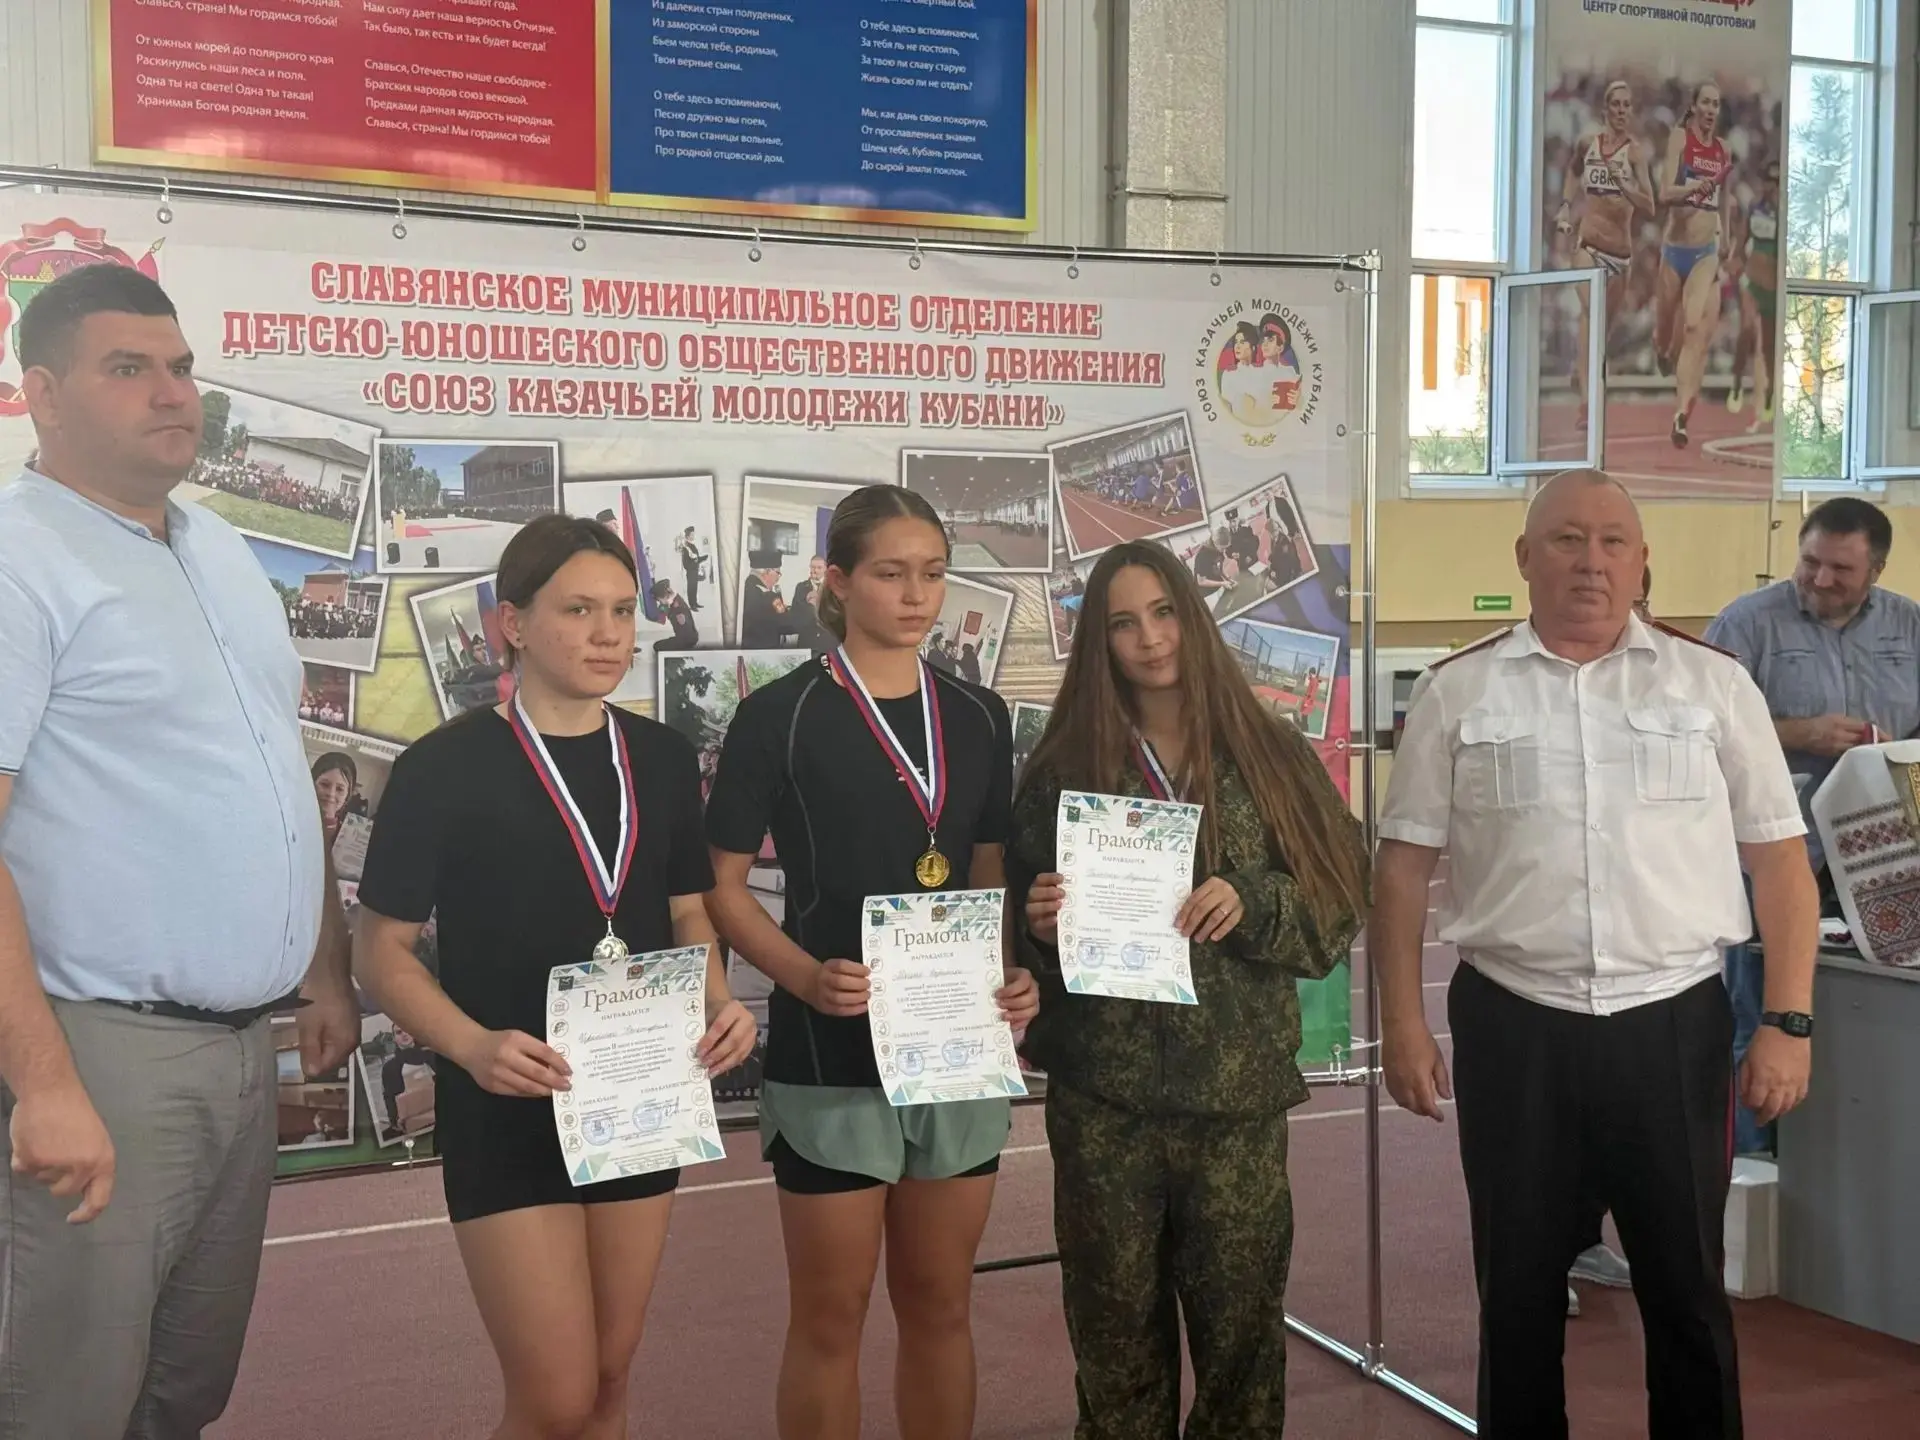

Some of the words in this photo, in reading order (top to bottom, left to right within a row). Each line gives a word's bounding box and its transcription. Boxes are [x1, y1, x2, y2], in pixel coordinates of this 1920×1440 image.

[185, 2, 226, 13] страна!
[228, 4, 247, 15] Мы
[249, 9, 301, 21] гордимся
[303, 15, 337, 26] тобой!
[363, 0, 384, 12] Нам
[386, 6, 410, 17] силу
[412, 9, 435, 18] дает
[437, 12, 463, 22] наша
[465, 16, 511, 28] верность
[513, 19, 556, 34] Отчизне.
[652, 0, 664, 8] Из
[666, 2, 704, 12] далеких
[706, 6, 733, 15] стран
[1583, 0, 1617, 14] ЦЕНТР
[1619, 4, 1688, 22] СПОРТИВНОЙ
[1690, 12, 1756, 30] ПОДГОТОВКИ
[363, 20, 380, 31] Так
[382, 22, 412, 35] было,
[414, 28, 430, 37] так
[432, 30, 454, 40] есть
[464, 34, 481, 43] так
[482, 35, 509, 47] будет
[512, 40, 546, 51] всегда!
[652, 17, 664, 27] Из
[666, 21, 717, 31] заморской
[719, 26, 759, 36] стороны
[860, 19, 868, 28] О
[869, 21, 889, 31] тебе
[891, 24, 916, 33] здесь
[135, 33, 150, 44] От
[153, 38, 191, 48] южных
[194, 42, 230, 53] морей
[232, 46, 246, 55] до
[248, 48, 306, 61] полярного
[308, 55, 334, 64] края
[652, 35, 677, 46] Бьем
[678, 40, 708, 48] челом
[860, 36, 871, 46] За
[872, 39, 892, 48] тебя
[136, 54, 206, 70] Раскинулись
[209, 64, 238, 73] наши
[241, 66, 265, 76] леса
[268, 69, 274, 77] и
[277, 70, 306, 80] поля.
[364, 58, 409, 73] Славься,
[410, 64, 464, 78] Отечество
[465, 73, 492, 82] наше
[493, 75, 546, 88] свободное
[654, 53, 675, 64] Твои
[677, 58, 713, 68] верные
[861, 54, 871, 64] За
[872, 58, 895, 66] твою
[909, 61, 934, 71] славу
[935, 63, 966, 73] старую
[136, 74, 165, 86] Одна
[168, 79, 182, 87] ты
[184, 81, 197, 89] на
[200, 82, 233, 92] свете!
[235, 83, 263, 95] Одна
[265, 88, 279, 97] ты
[282, 90, 313, 100] такая!
[364, 78, 411, 91] Братских
[413, 86, 457, 97] народов
[458, 90, 483, 99] союз
[485, 93, 528, 104] вековой.
[860, 73, 890, 83] Жизнь
[891, 77, 914, 85] свою
[928, 80, 939, 88] не
[940, 81, 972, 90] отдать?
[136, 94, 192, 108] Хранимая
[195, 99, 229, 111] Богом
[231, 105, 271, 116] родная
[274, 109, 308, 119] земля.
[653, 89, 662, 100] О
[663, 92, 685, 101] тебе
[687, 95, 713, 104] здесь
[365, 96, 417, 111] Предками
[419, 105, 455, 115] данная
[457, 109, 504, 120] мудрость
[506, 115, 554, 126] народная.
[654, 108, 685, 119] Песню
[686, 113, 723, 122] дружно
[896, 112, 918, 120] дань
[919, 114, 941, 122] свою
[365, 116, 410, 130] Славься,
[412, 123, 449, 133] страна!
[451, 125, 468, 135] Мы
[470, 129, 517, 140] гордимся
[519, 133, 550, 144] тобой!
[654, 126, 674, 138] Про
[676, 130, 698, 138] твои
[699, 132, 738, 142] станицы
[860, 124, 873, 134] От
[874, 128, 942, 139] прославленных
[945, 134, 975, 142] знамен
[655, 144, 674, 156] Про
[676, 148, 712, 157] родной
[713, 151, 762, 160] отцовский
[861, 143, 887, 152] Шлем
[912, 147, 942, 157] Кубань
[860, 159, 874, 170] До
[875, 163, 904, 172] сырой
[906, 165, 931, 173] земли
[311, 261, 568, 312] СЛАВЯНСКОЕ
[582, 278, 898, 328] МУНИЦИПАЛЬНОЕ
[909, 296, 1100, 337] ОТДЕЛЕНИЕ
[1196, 300, 1243, 367] КАЗАЧЬЕЙ
[1251, 299, 1318, 354] МОЛОДЁЖИ
[222, 311, 666, 368] ДЕТСКО-ЮНОШЕСКОГО
[678, 333, 974, 380] ОБЩЕСТВЕННОГО
[985, 348, 1164, 386] ДВИЖЕНИЯ
[363, 373, 493, 414] «СОЮЗ
[508, 377, 699, 420] КАЗАЧЬЕЙ
[712, 386, 909, 428] МОЛОДЕЖИ
[920, 393, 1063, 428] КУБАНИ»
[1195, 378, 1218, 422] СОЮЗ
[1300, 363, 1322, 425] КУБАНИ
[1087, 827, 1163, 852] Грамота
[893, 928, 970, 952] Грамота
[583, 984, 669, 1013] Грамота
